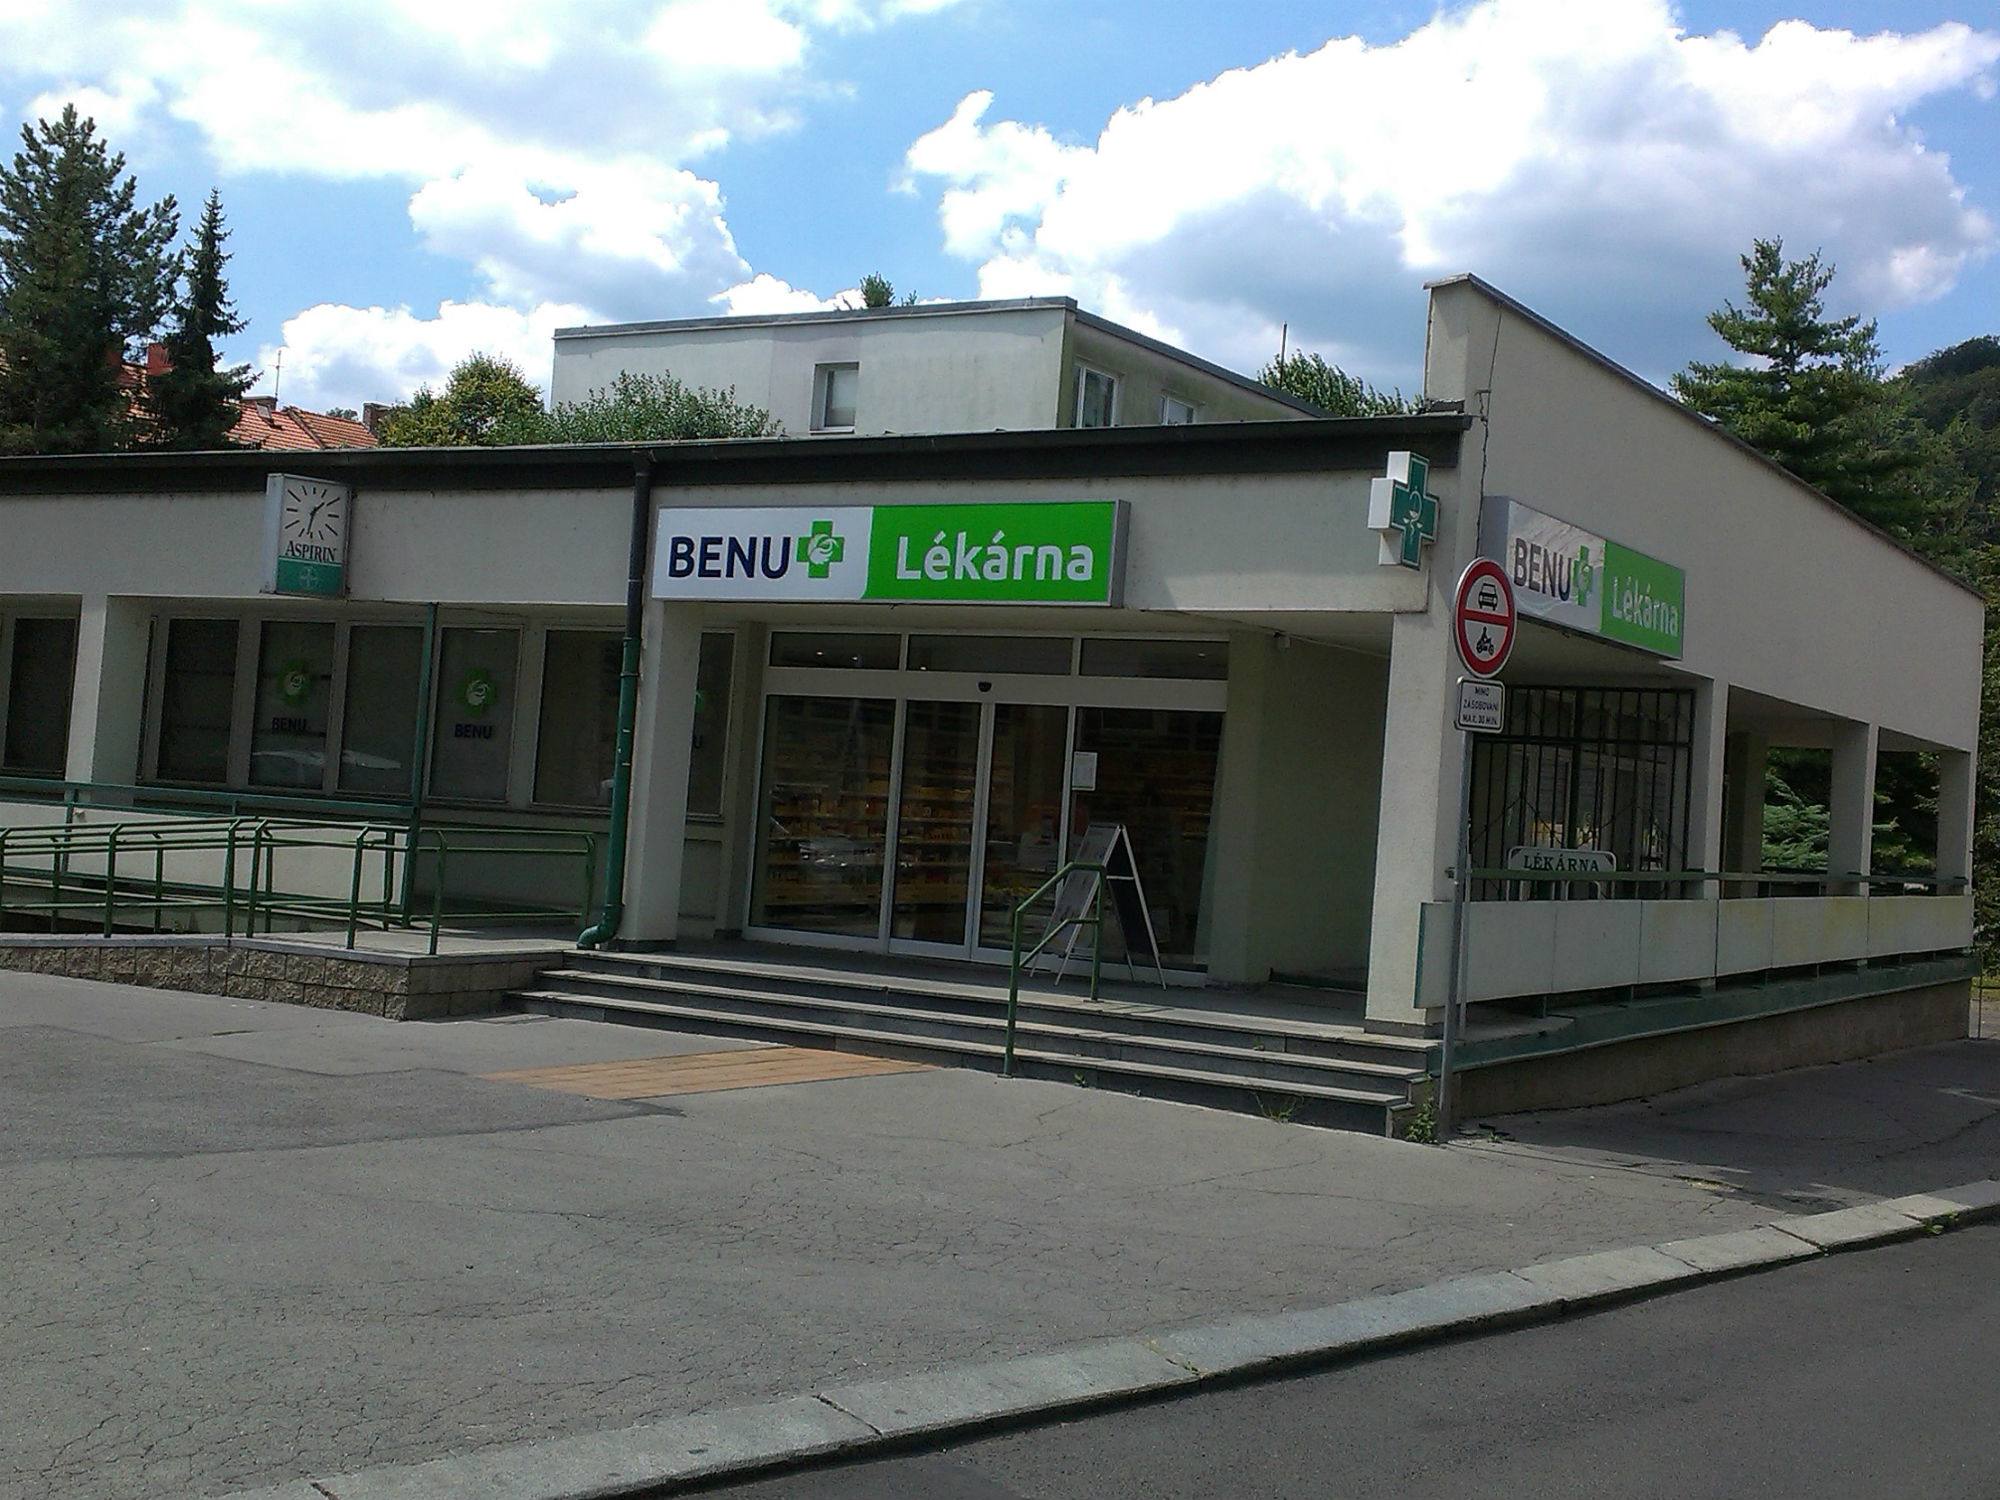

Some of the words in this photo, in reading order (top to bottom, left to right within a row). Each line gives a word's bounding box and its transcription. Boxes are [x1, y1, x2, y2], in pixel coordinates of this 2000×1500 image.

[285, 540, 337, 563] ASPIRIN
[668, 536, 791, 579] BENU
[896, 529, 1094, 581] Lékárna
[1514, 537, 1573, 602] BENU
[1612, 575, 1679, 637] Lékárna
[271, 716, 308, 734] BENU
[454, 723, 493, 740] BENU
[1524, 852, 1600, 872] LÉKÁRNA
